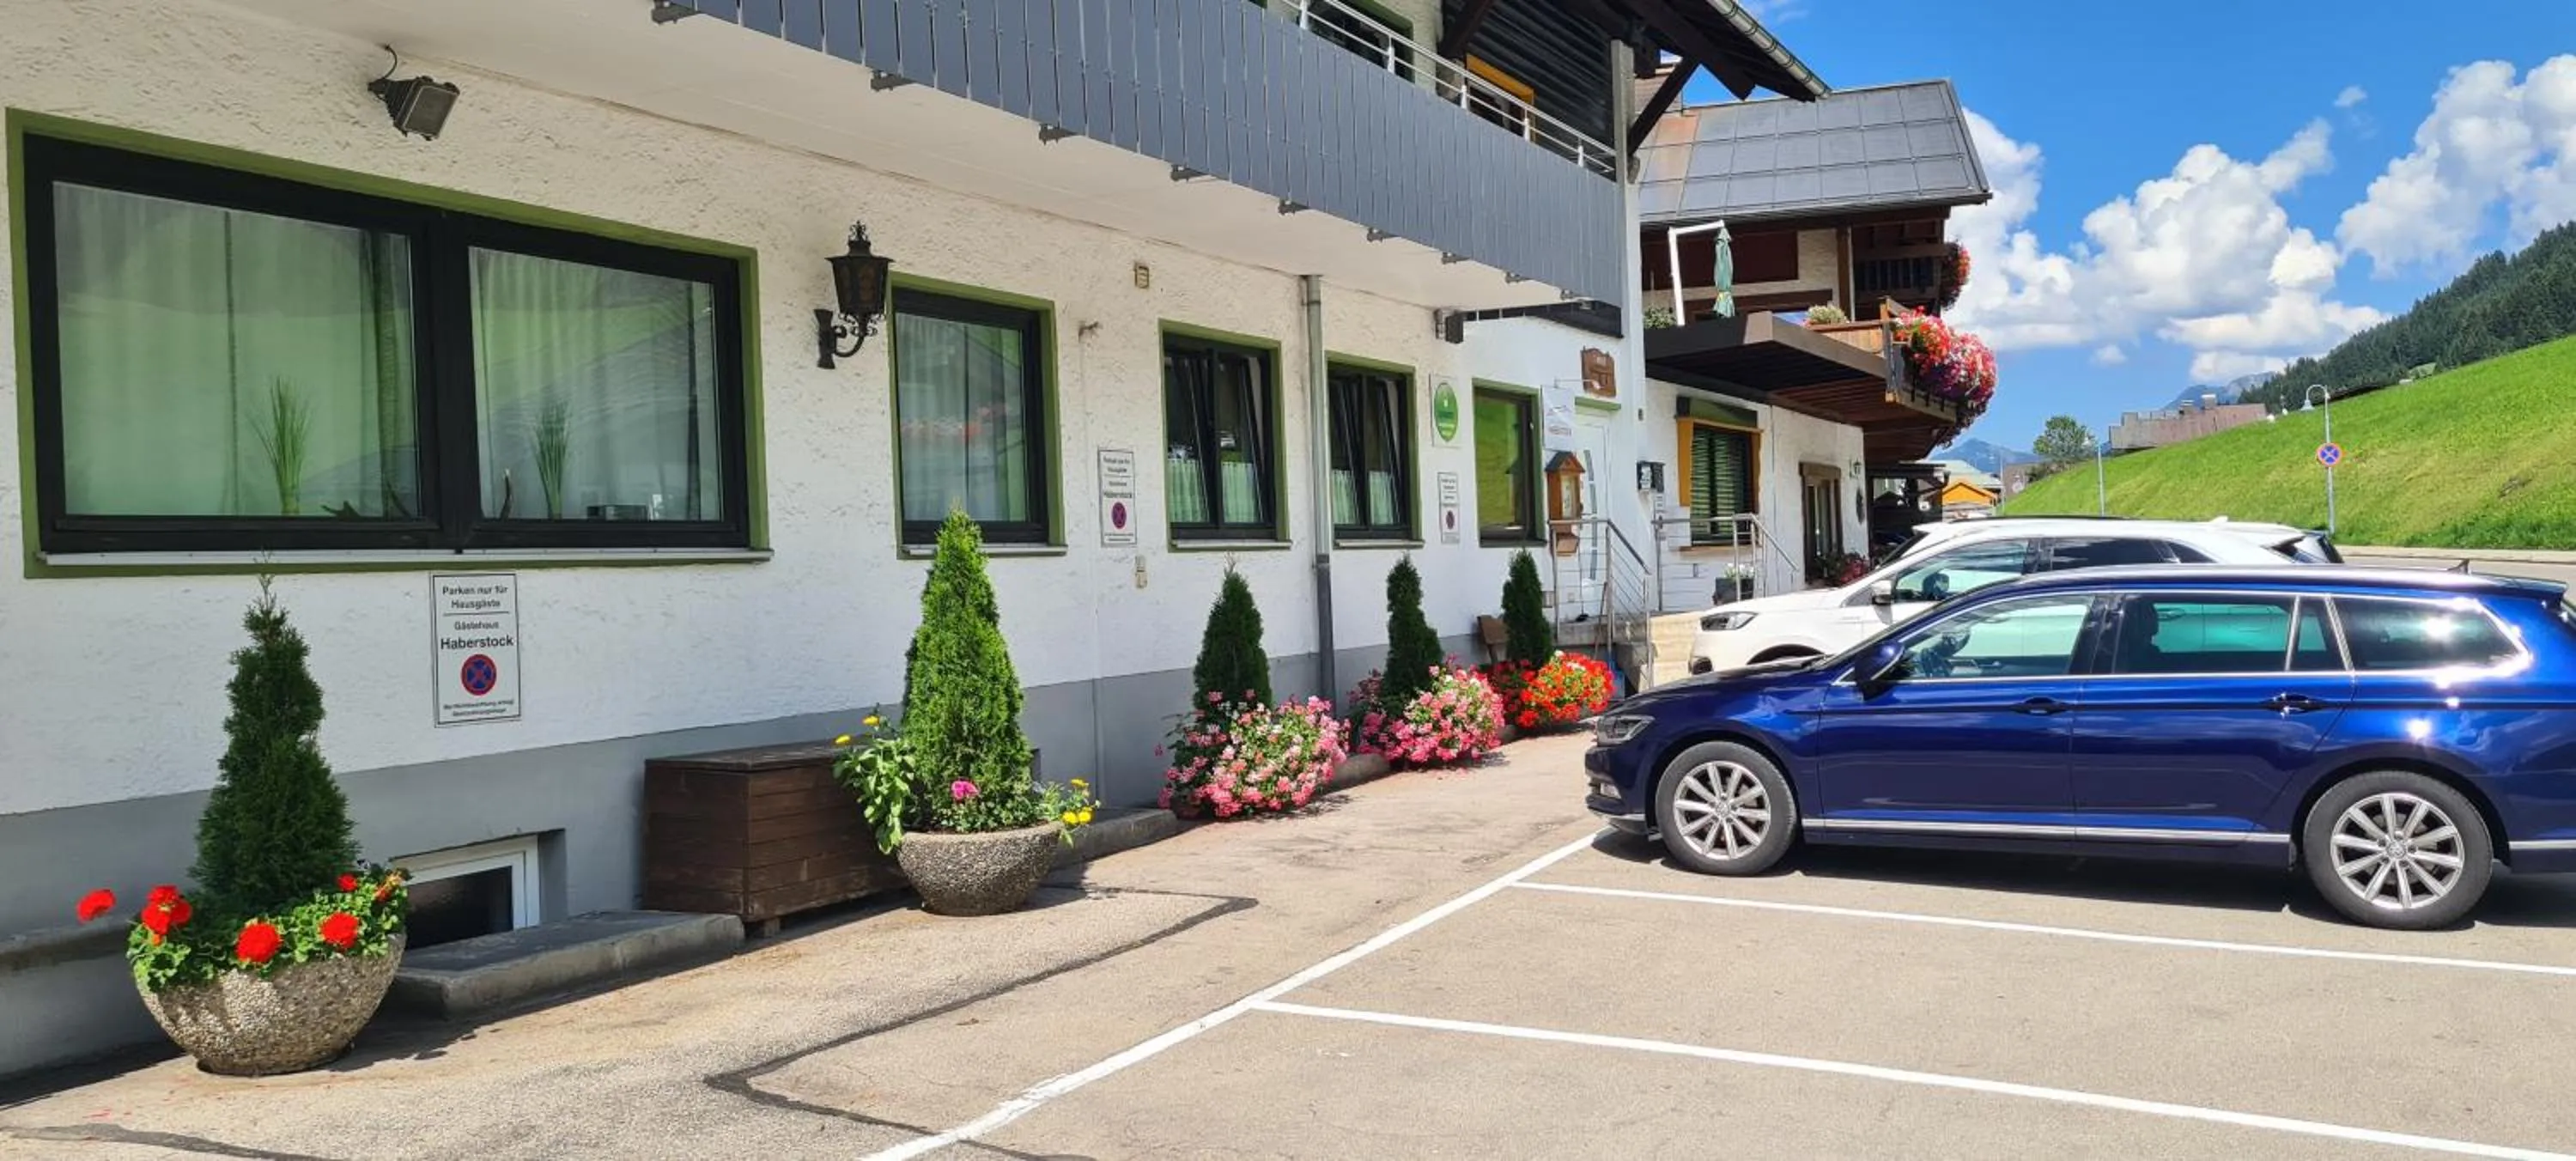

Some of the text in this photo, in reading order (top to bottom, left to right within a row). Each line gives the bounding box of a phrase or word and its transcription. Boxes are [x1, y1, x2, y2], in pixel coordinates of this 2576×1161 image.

[442, 586, 475, 595] Parken
[495, 585, 508, 593] für
[451, 599, 501, 610] Hausgäste
[453, 621, 500, 630] Gästehaus
[440, 635, 514, 649] Haberstock
